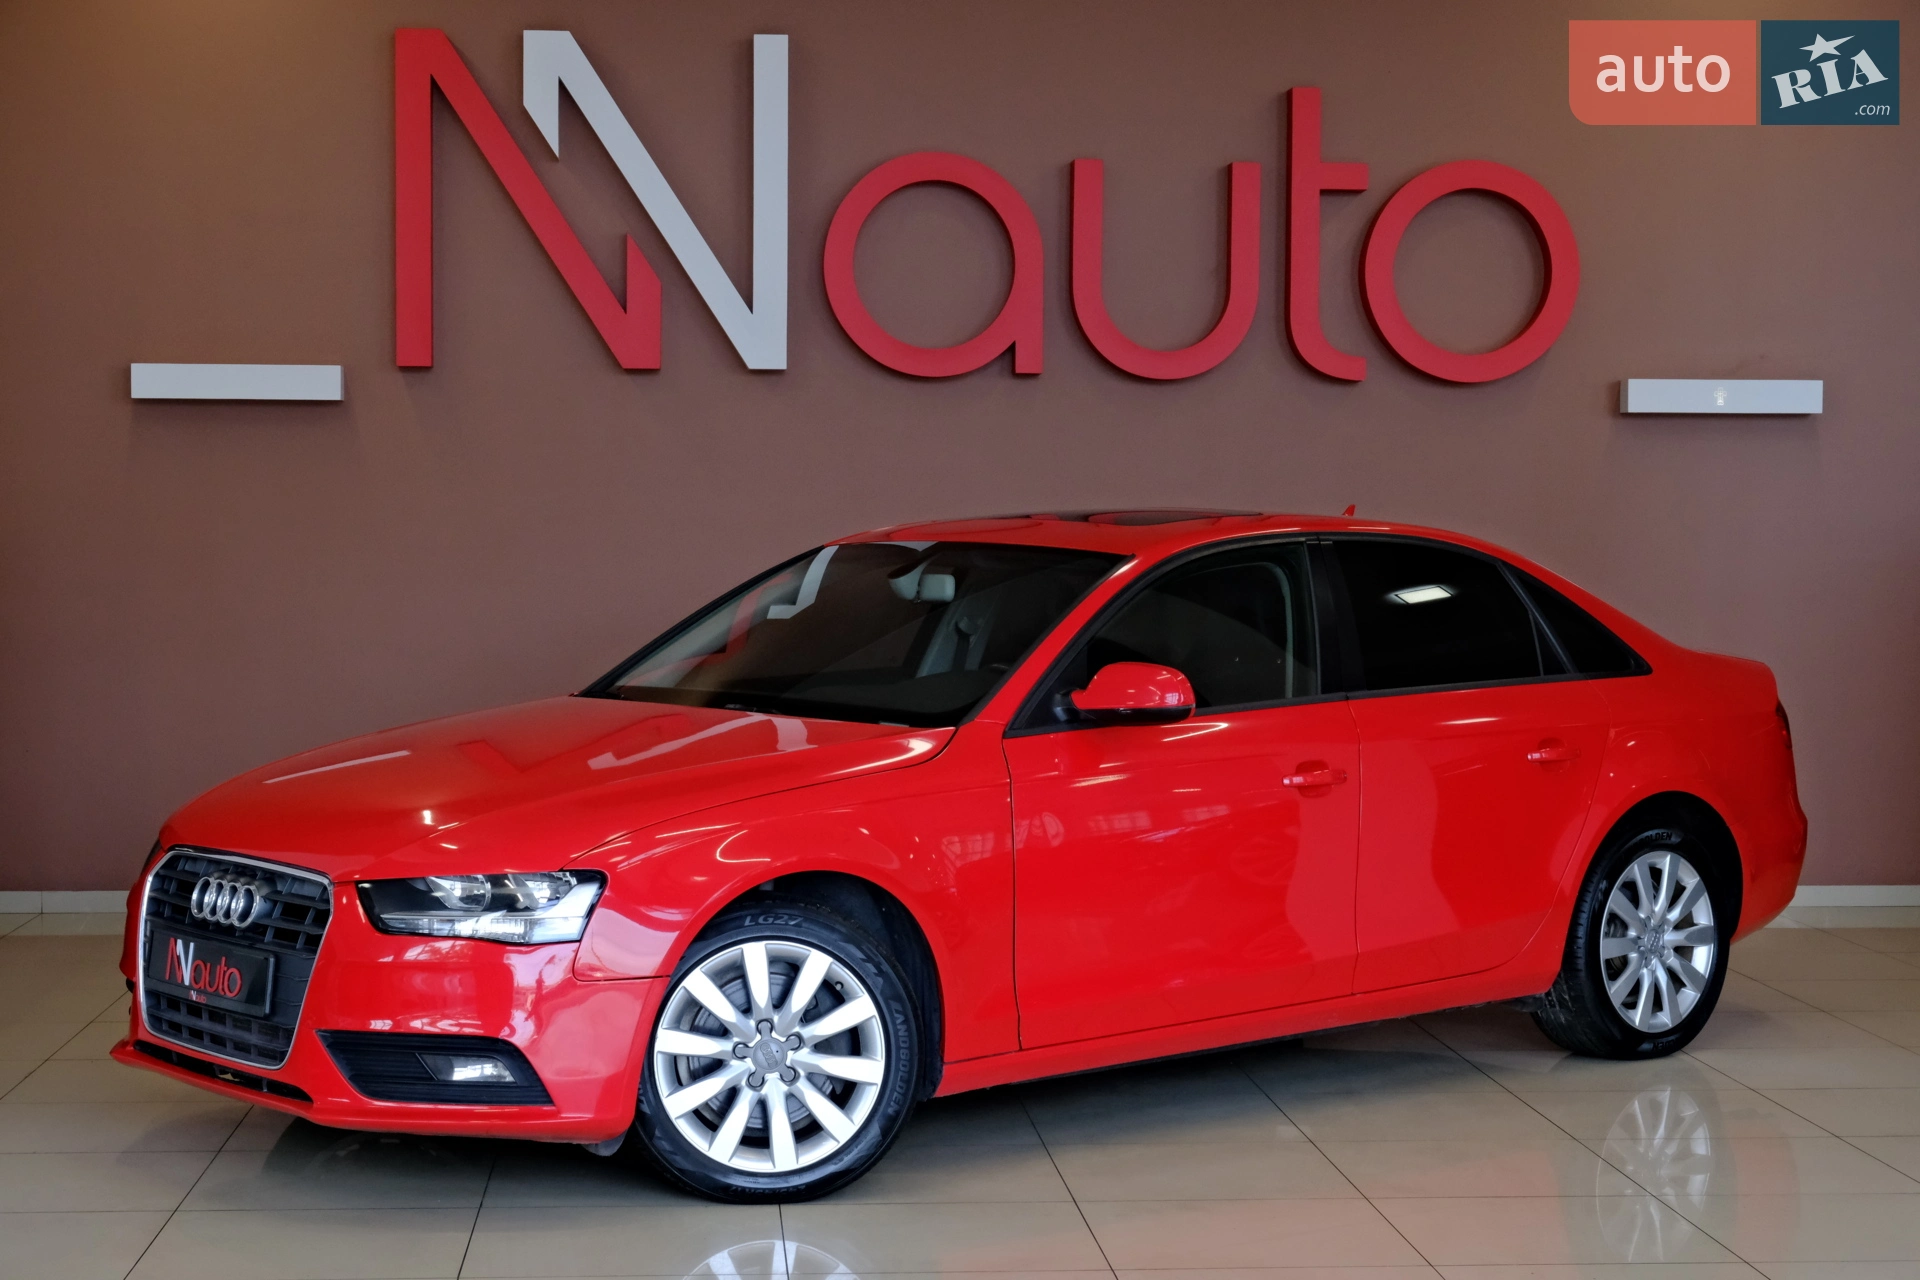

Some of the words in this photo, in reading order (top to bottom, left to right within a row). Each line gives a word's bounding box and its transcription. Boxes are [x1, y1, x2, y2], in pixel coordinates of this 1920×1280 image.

[395, 28, 1580, 383] NNauto
[743, 913, 804, 927] LG27
[165, 937, 242, 998] NNauto
